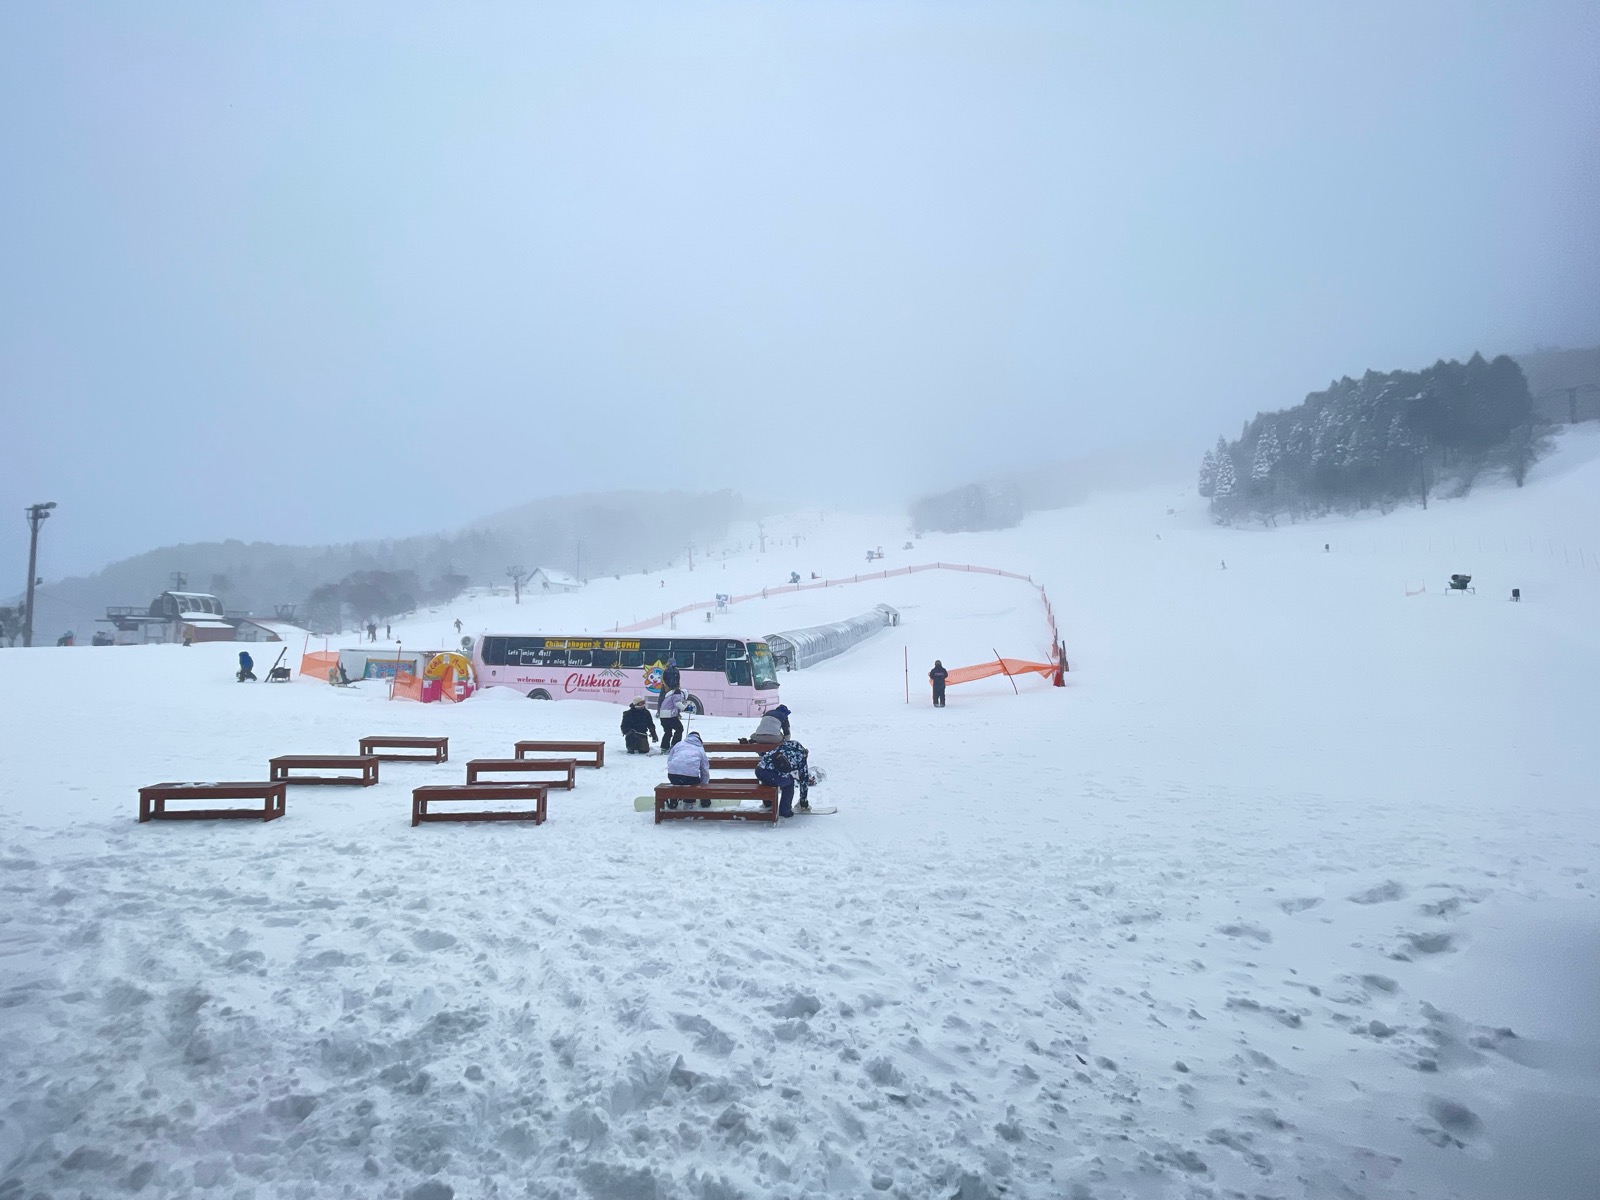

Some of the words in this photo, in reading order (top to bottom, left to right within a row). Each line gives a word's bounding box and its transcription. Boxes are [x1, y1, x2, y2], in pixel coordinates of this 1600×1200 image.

[545, 641, 592, 650] Chikuakogen
[517, 676, 546, 684] welcome
[564, 672, 623, 694] Chikusa
